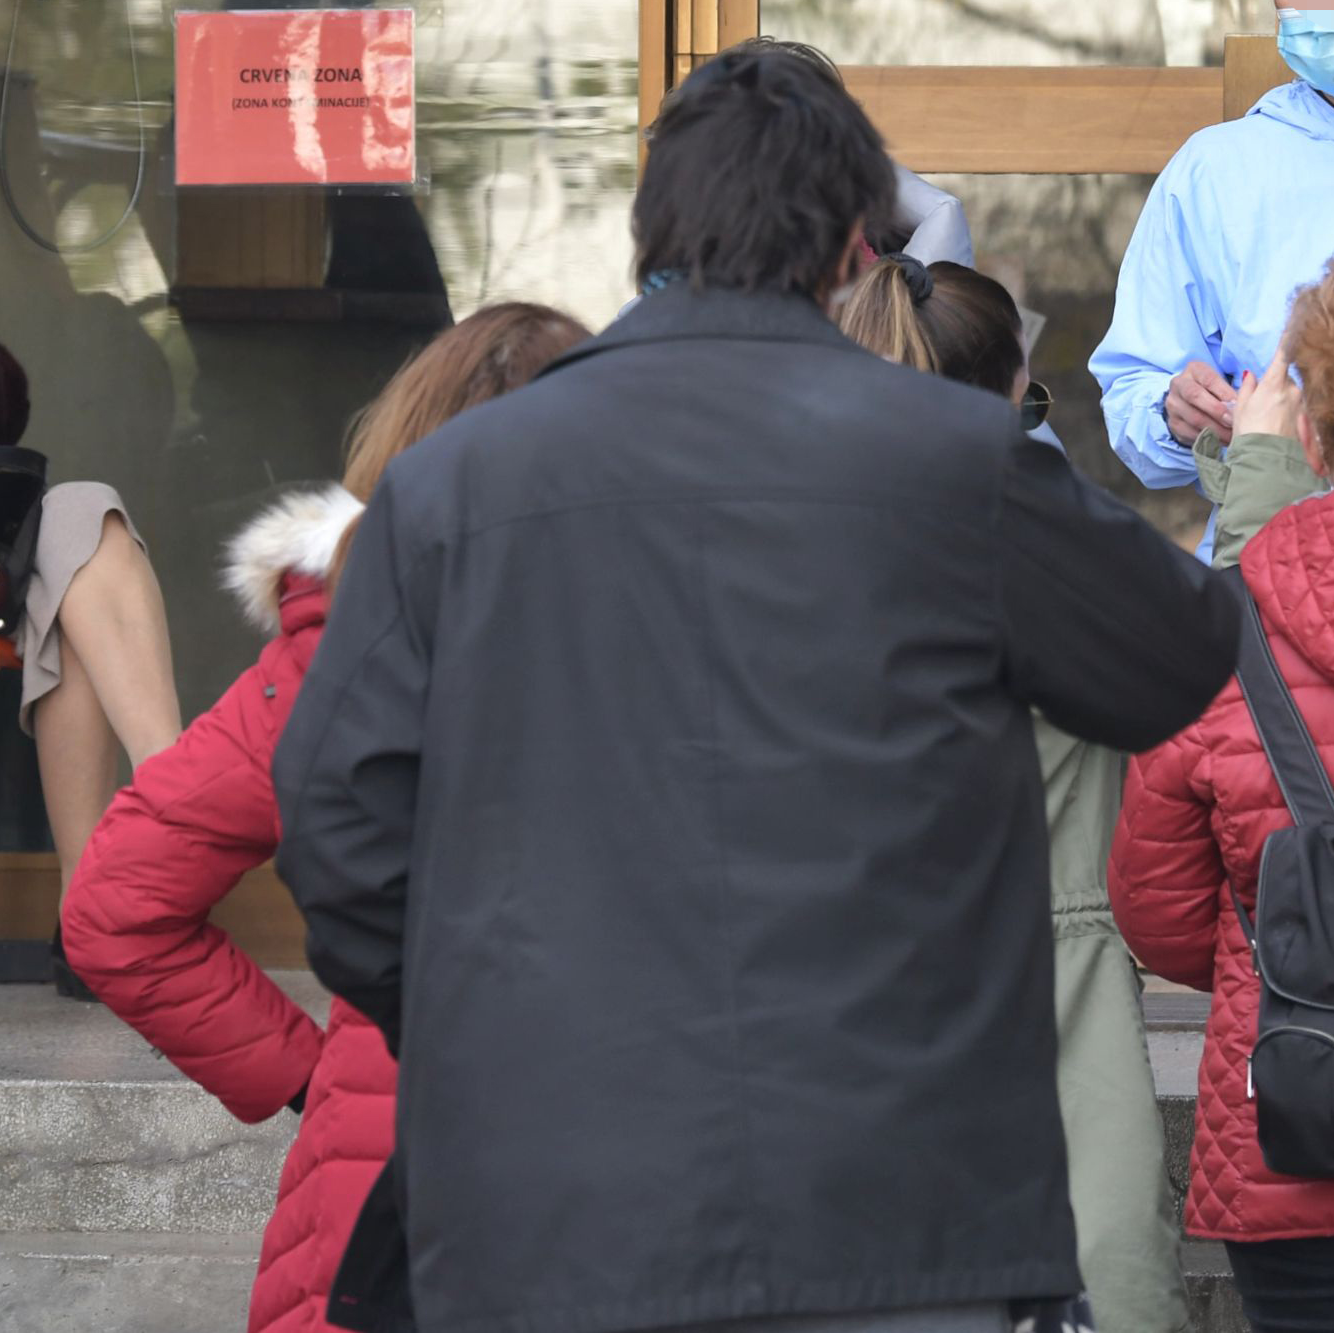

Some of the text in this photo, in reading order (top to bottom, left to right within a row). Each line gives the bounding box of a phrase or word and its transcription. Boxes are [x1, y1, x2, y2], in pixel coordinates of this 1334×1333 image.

[239, 68, 362, 83] CRVENA ZONA
[232, 97, 370, 110] (ZONA KONTMINACIJE)
